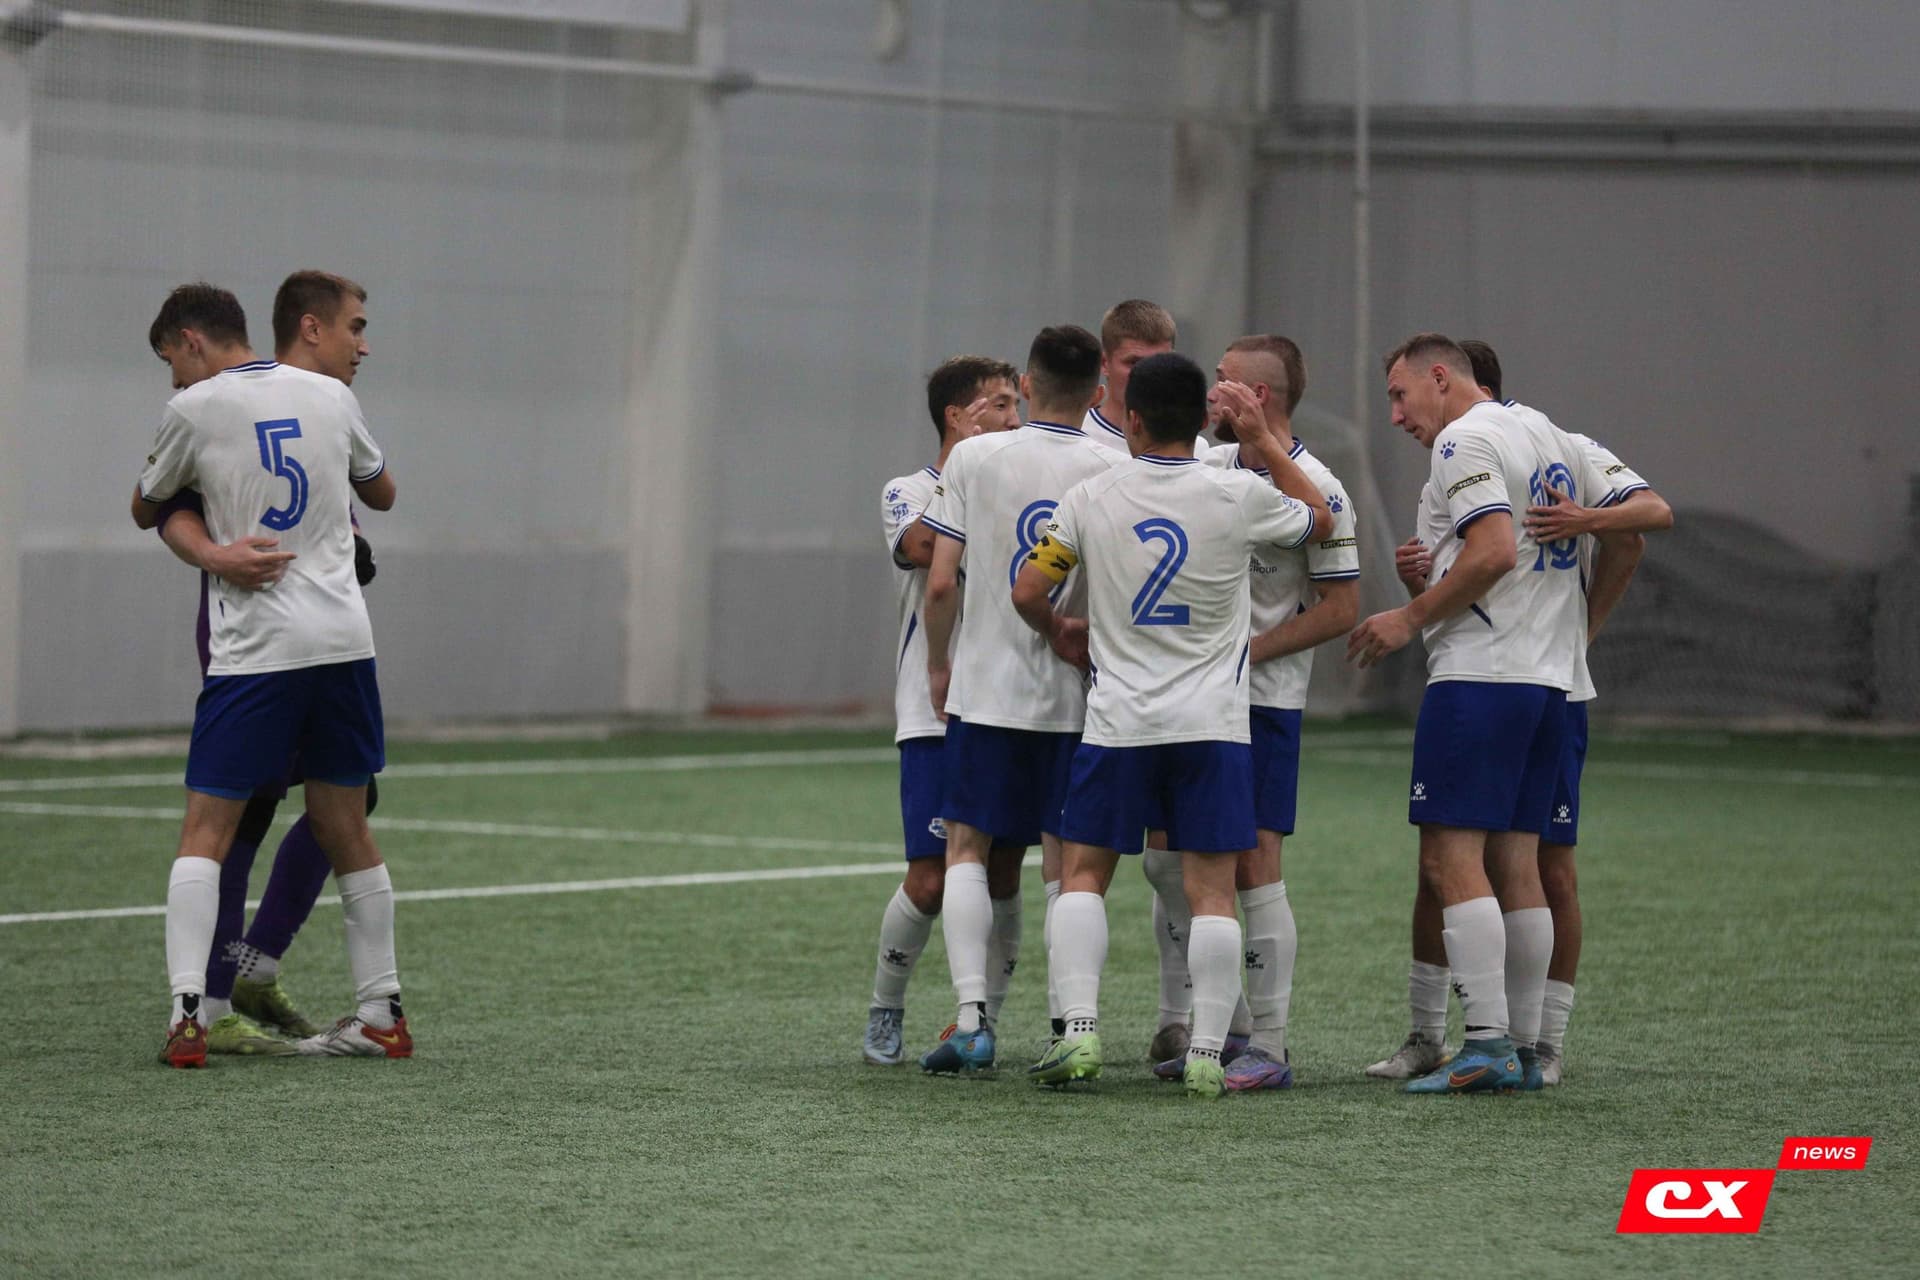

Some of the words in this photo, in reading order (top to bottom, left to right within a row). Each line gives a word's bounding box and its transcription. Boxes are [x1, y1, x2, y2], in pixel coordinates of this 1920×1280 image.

[254, 417, 309, 532] 5
[1009, 499, 1068, 606] 8
[1131, 517, 1191, 626] 2
